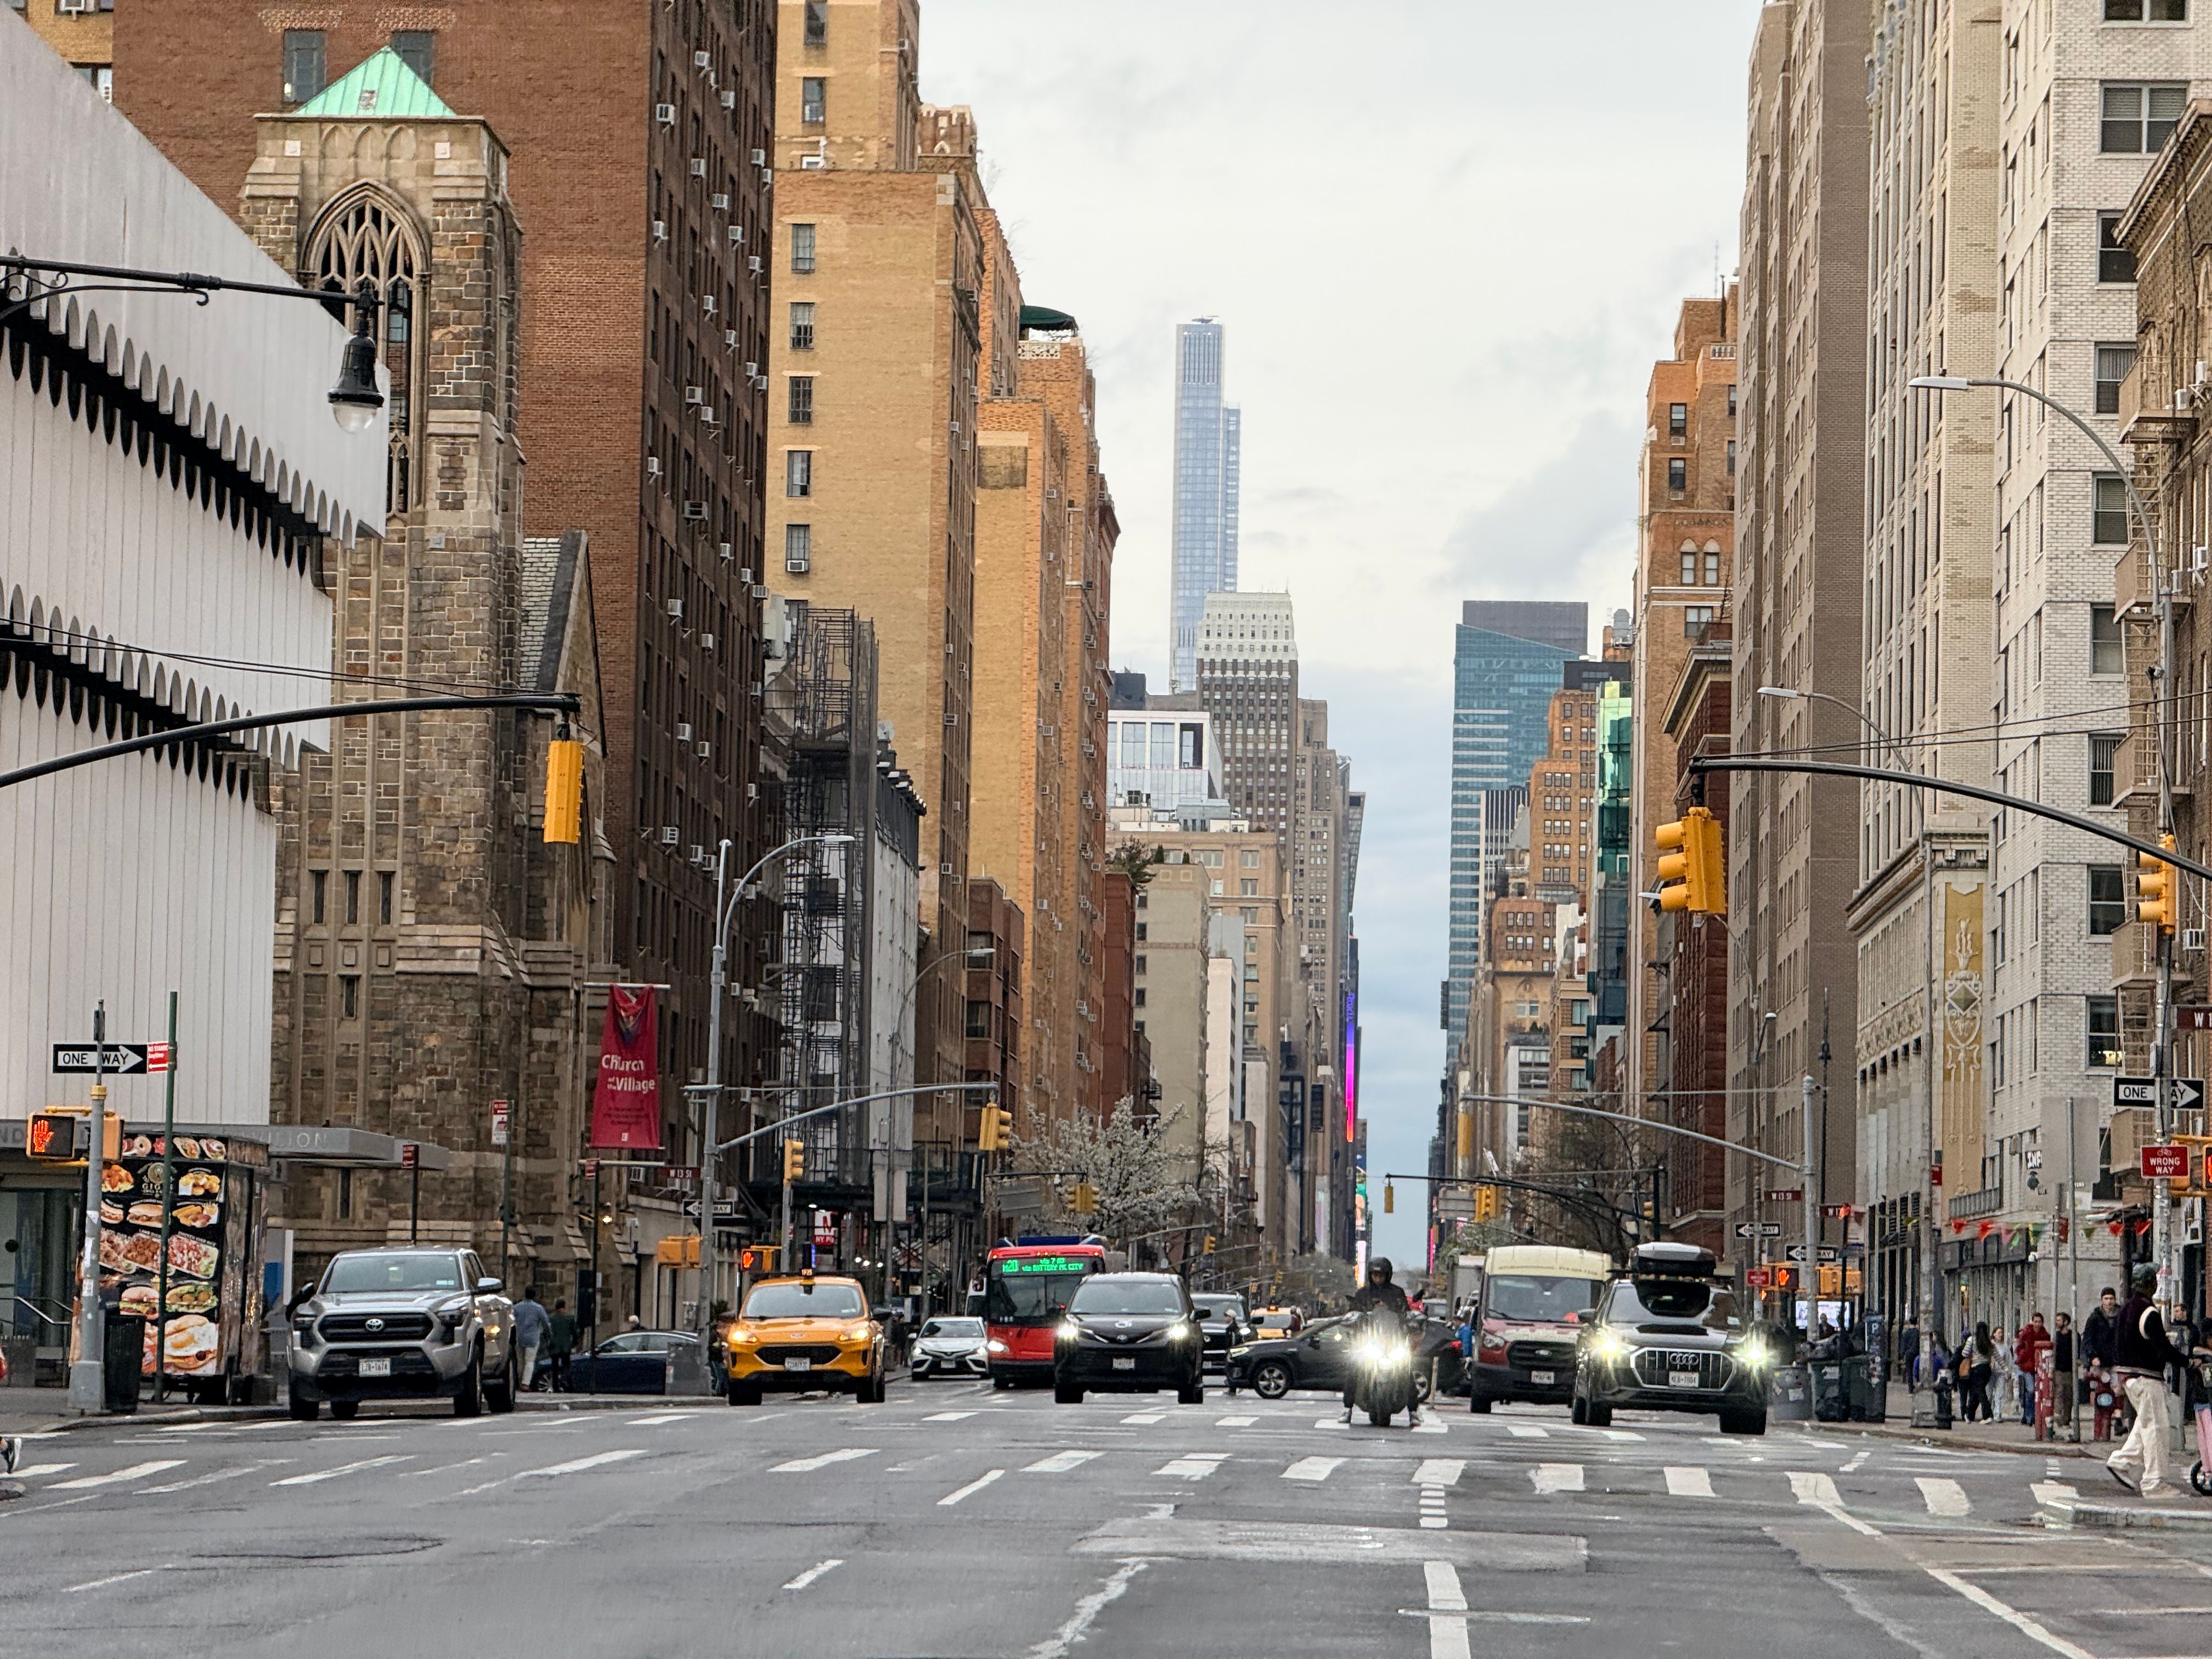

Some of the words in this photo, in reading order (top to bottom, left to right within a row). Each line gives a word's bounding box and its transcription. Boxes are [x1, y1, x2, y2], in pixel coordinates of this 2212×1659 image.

[63, 1053, 88, 1064] ONE
[102, 1053, 128, 1064] WAY
[602, 1054, 644, 1071] Church
[616, 1077, 655, 1094] Village
[2124, 1087, 2147, 1098] ONE
[2171, 1088, 2186, 1100] AY
[2150, 1158, 2180, 1166] WRONG
[670, 1169, 675, 1177] W
[2156, 1166, 2174, 1175] WAY
[1871, 1323, 1879, 1334] P
